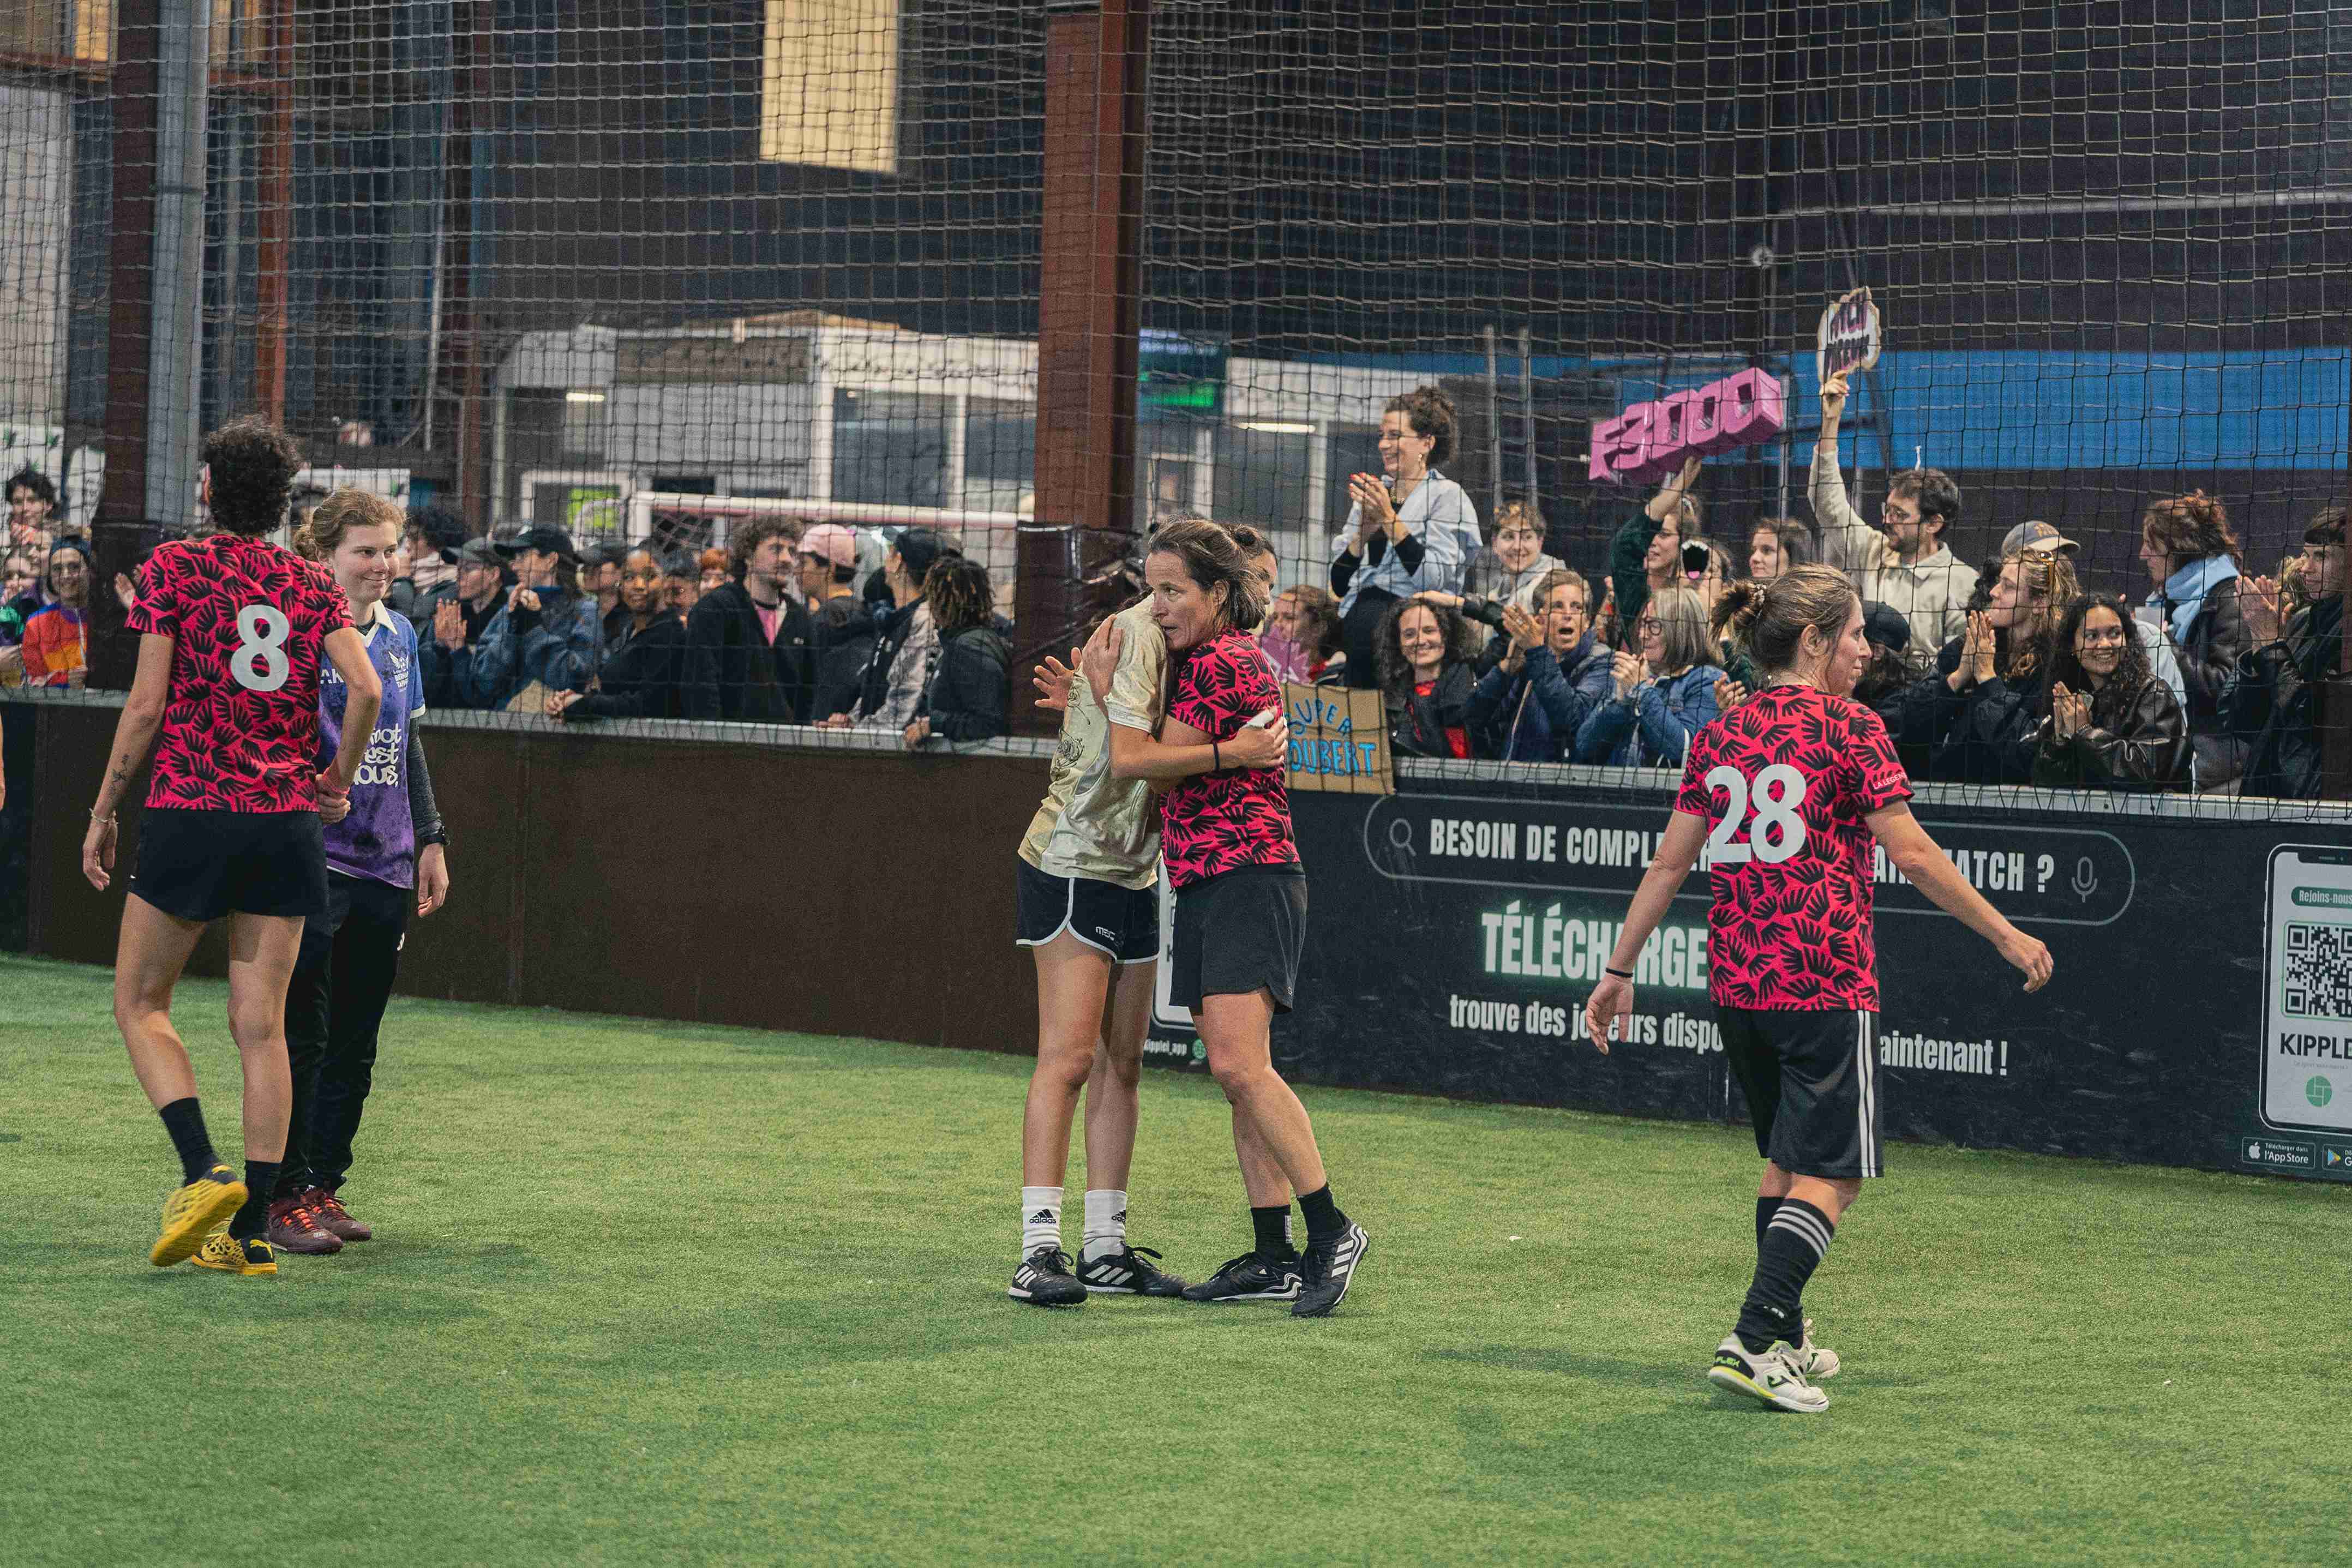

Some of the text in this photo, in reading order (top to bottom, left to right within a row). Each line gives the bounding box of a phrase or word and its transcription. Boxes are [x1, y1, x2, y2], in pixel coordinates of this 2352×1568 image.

[231, 604, 290, 692] 8
[1288, 738, 1377, 777] OUBERT
[1705, 764, 1807, 863] 28
[1430, 818, 1516, 860] BESOIN
[1526, 825, 1557, 863] DE
[1942, 849, 2025, 892] ATCH
[2037, 854, 2055, 893] ?
[1449, 994, 1520, 1033] trouve
[1525, 1001, 1566, 1037] des
[1663, 1012, 1724, 1055] dispo
[1880, 1030, 1994, 1075] aintenant
[2000, 1041, 2008, 1076] !
[2265, 1143, 2295, 1152] Télécharger
[2286, 1152, 2309, 1164] Store
[1029, 1215, 1057, 1224] adidas
